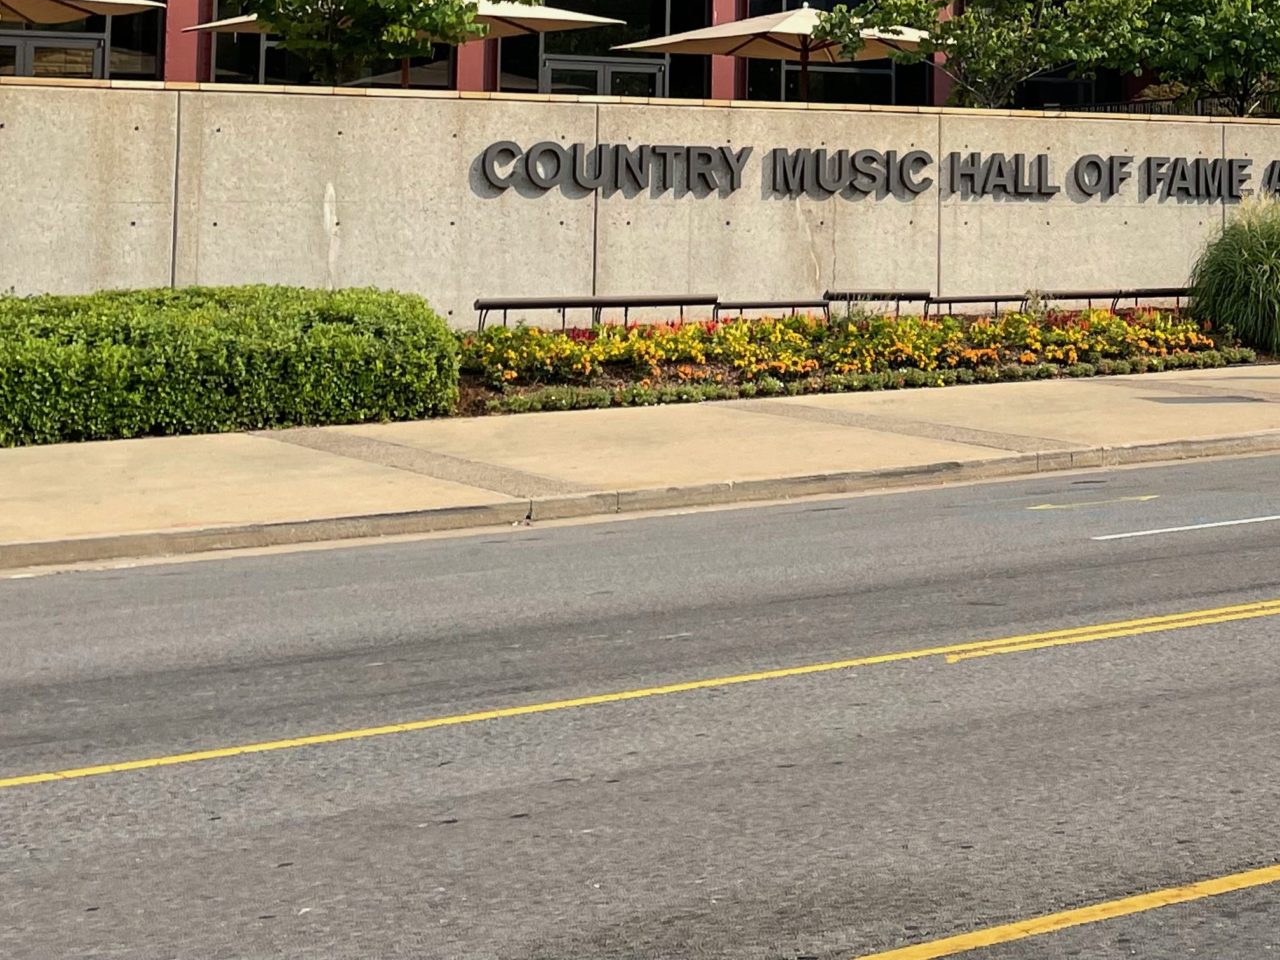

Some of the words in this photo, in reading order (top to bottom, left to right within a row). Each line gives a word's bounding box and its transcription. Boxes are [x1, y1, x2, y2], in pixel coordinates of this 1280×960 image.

[481, 140, 754, 190] COUNTRY
[771, 148, 934, 194] MUSIC
[950, 152, 1061, 196] HALL
[1074, 154, 1134, 197] OF
[1146, 157, 1254, 199] FAME
